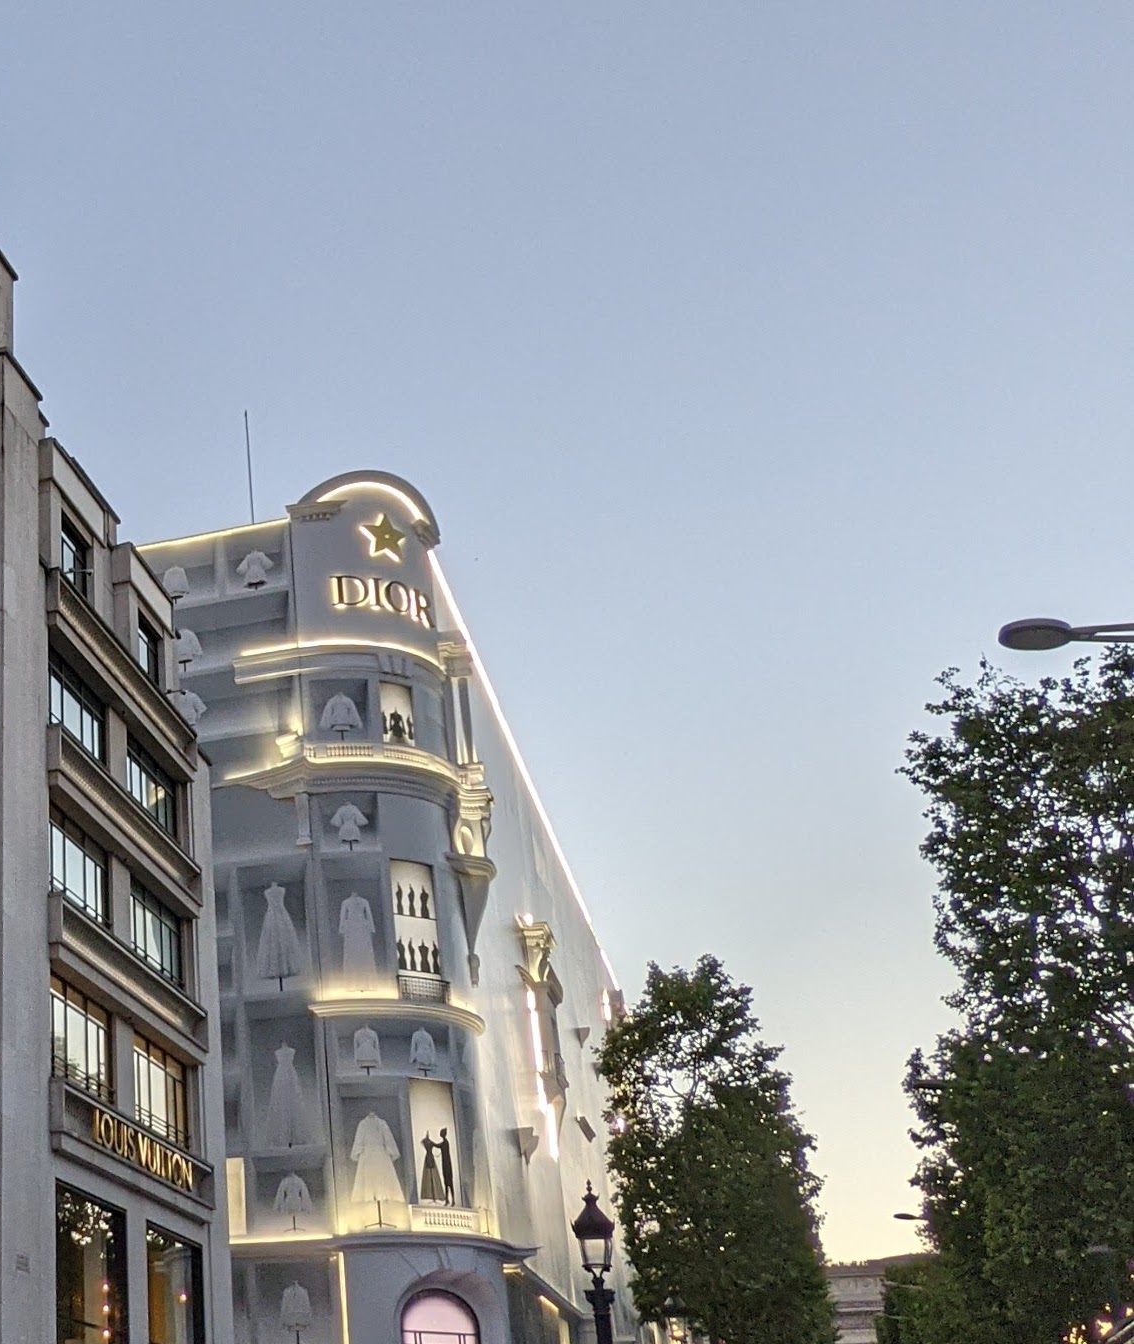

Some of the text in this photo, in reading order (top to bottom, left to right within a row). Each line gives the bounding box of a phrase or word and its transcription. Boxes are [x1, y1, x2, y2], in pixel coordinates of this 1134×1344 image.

[330, 575, 435, 628] DIOR
[92, 1108, 193, 1192] LOUIS VUITTON
